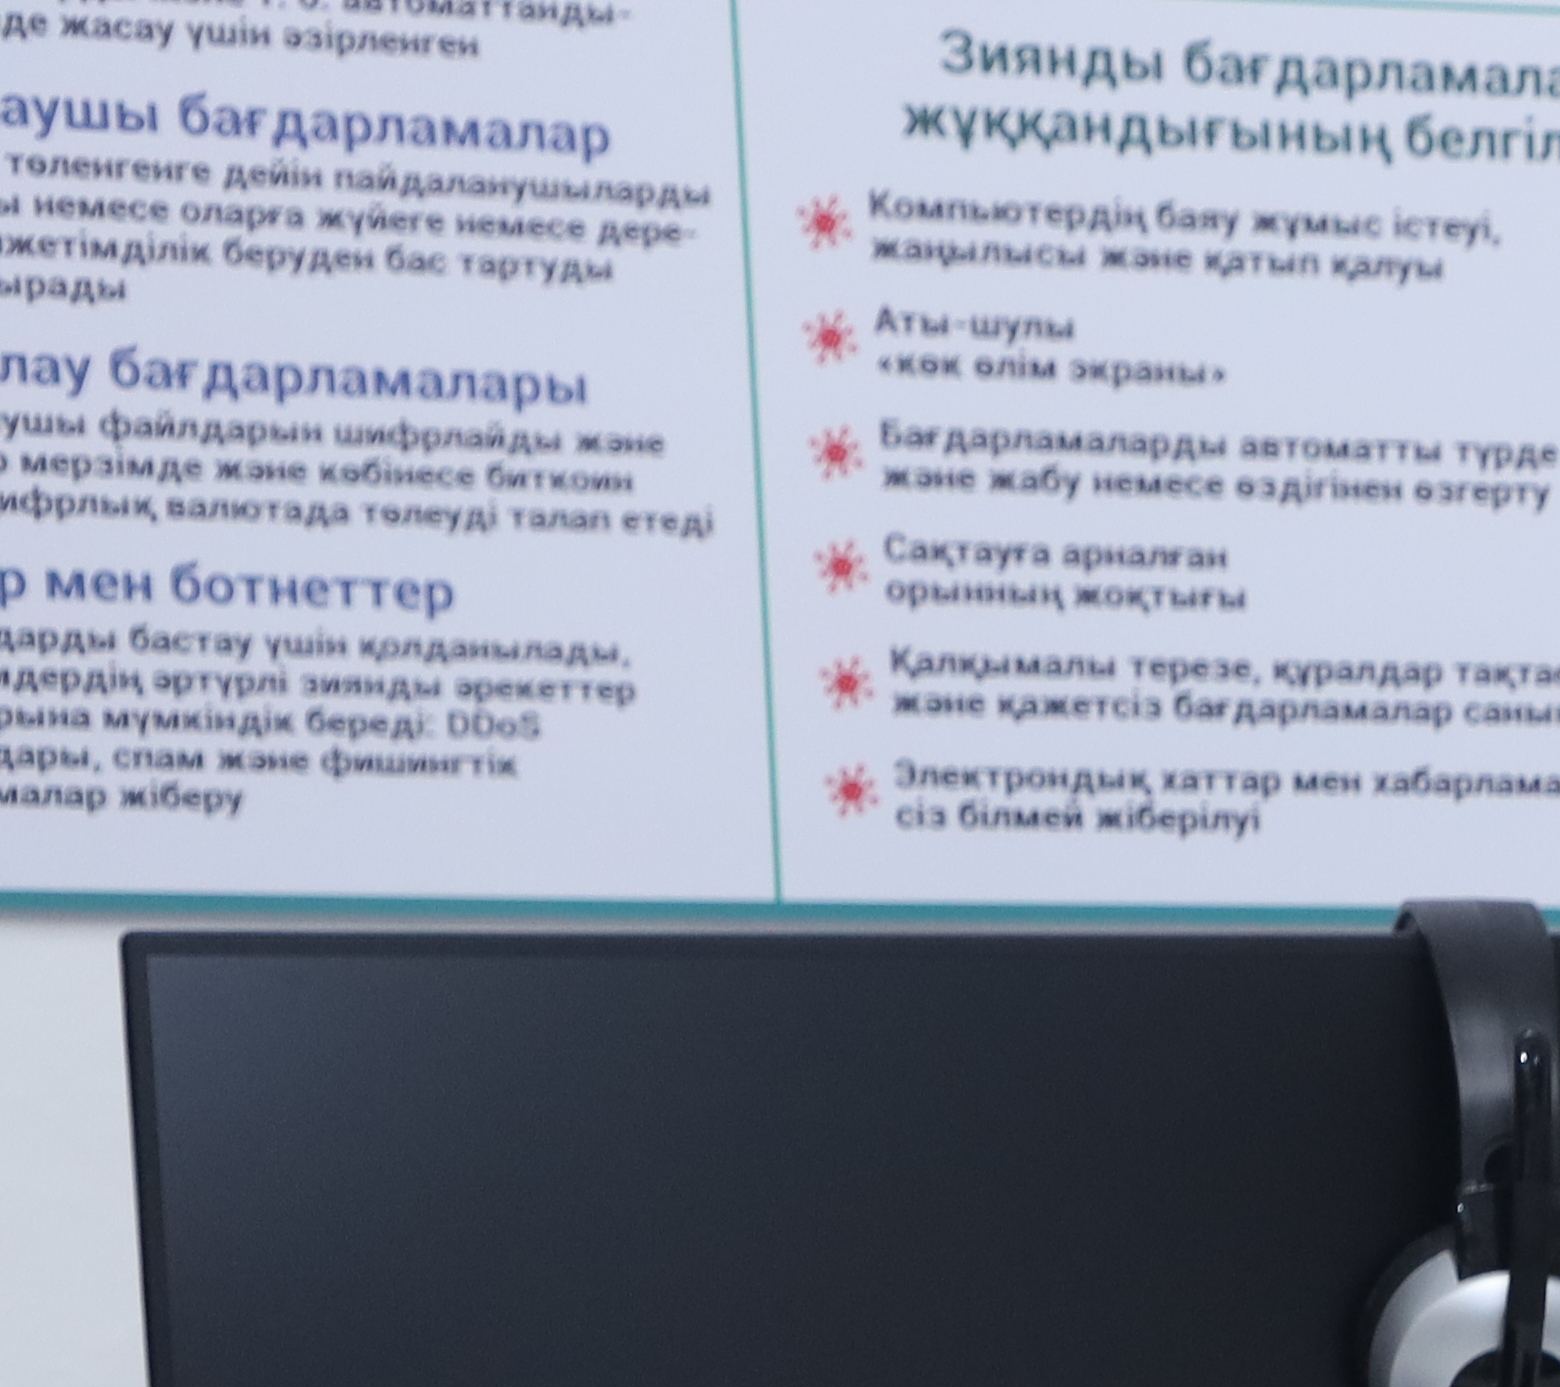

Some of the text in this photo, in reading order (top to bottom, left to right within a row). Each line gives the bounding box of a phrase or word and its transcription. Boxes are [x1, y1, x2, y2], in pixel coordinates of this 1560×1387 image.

[59, 14, 174, 50] жасау
[186, 19, 271, 52] үшін
[283, 25, 479, 59] әзірленген
[940, 28, 1163, 91] Зиянды
[178, 91, 610, 163] бағдарламалар
[5, 152, 211, 186] төленгенге
[222, 157, 323, 193] дейін
[33, 195, 169, 224] немесе
[180, 201, 305, 237] оларға
[317, 202, 445, 238] жүйеге
[456, 214, 585, 243] немесе
[597, 220, 694, 251] дере-
[869, 189, 1149, 236] Компьютердің
[1156, 199, 1240, 241] баяу
[1394, 214, 1500, 249] істеуі,
[0, 229, 613, 286] жетімділік беруден бас тартуды
[872, 237, 1443, 287] жаңылысы және қатып қалуы
[874, 304, 1075, 348] Аты-шулы
[109, 344, 587, 410] бағдарламалары
[878, 353, 1226, 390] «көк өлім экраны»
[99, 408, 323, 447] файлдарын
[334, 418, 562, 458] шифрлайды
[576, 433, 664, 457] және
[1240, 436, 1442, 464] автоматты
[1457, 441, 1558, 472] түрде
[20, 447, 203, 482] мерзімде
[215, 459, 307, 485] және
[319, 456, 475, 490] көбінесе
[485, 461, 633, 494] биткоин
[883, 462, 1550, 514] және жабу немесе өздігінен өзгерту
[166, 496, 351, 530] валютада
[364, 503, 498, 536] төлеуді
[511, 507, 611, 533] талап
[621, 511, 714, 541] етеді
[884, 532, 1228, 575] Сақтауға арналған
[45, 568, 153, 603] мен
[170, 560, 454, 621] ботнеттер
[885, 580, 1246, 615] орынның жоқтығы
[128, 621, 253, 664] бастау
[265, 632, 348, 664] үшін
[359, 637, 630, 669] қолданылады,
[890, 645, 1116, 683] Қалқымалы
[1131, 656, 1260, 688] терезе,
[302, 674, 442, 704] зиянды
[455, 678, 636, 711] әрекеттер
[893, 692, 986, 718] және
[998, 692, 1163, 724] қажетсіз
[102, 707, 294, 740] мүмкіндік
[447, 708, 540, 740] DDoS
[112, 747, 205, 772] спам
[218, 750, 309, 775] және
[320, 745, 517, 781] фишингтік
[895, 758, 1155, 799] Электрондық
[1162, 769, 1282, 801] хаттар
[1293, 770, 1362, 795] мен
[120, 780, 243, 818] жіберу
[896, 794, 1261, 841] сіз білмей жіберілуі
